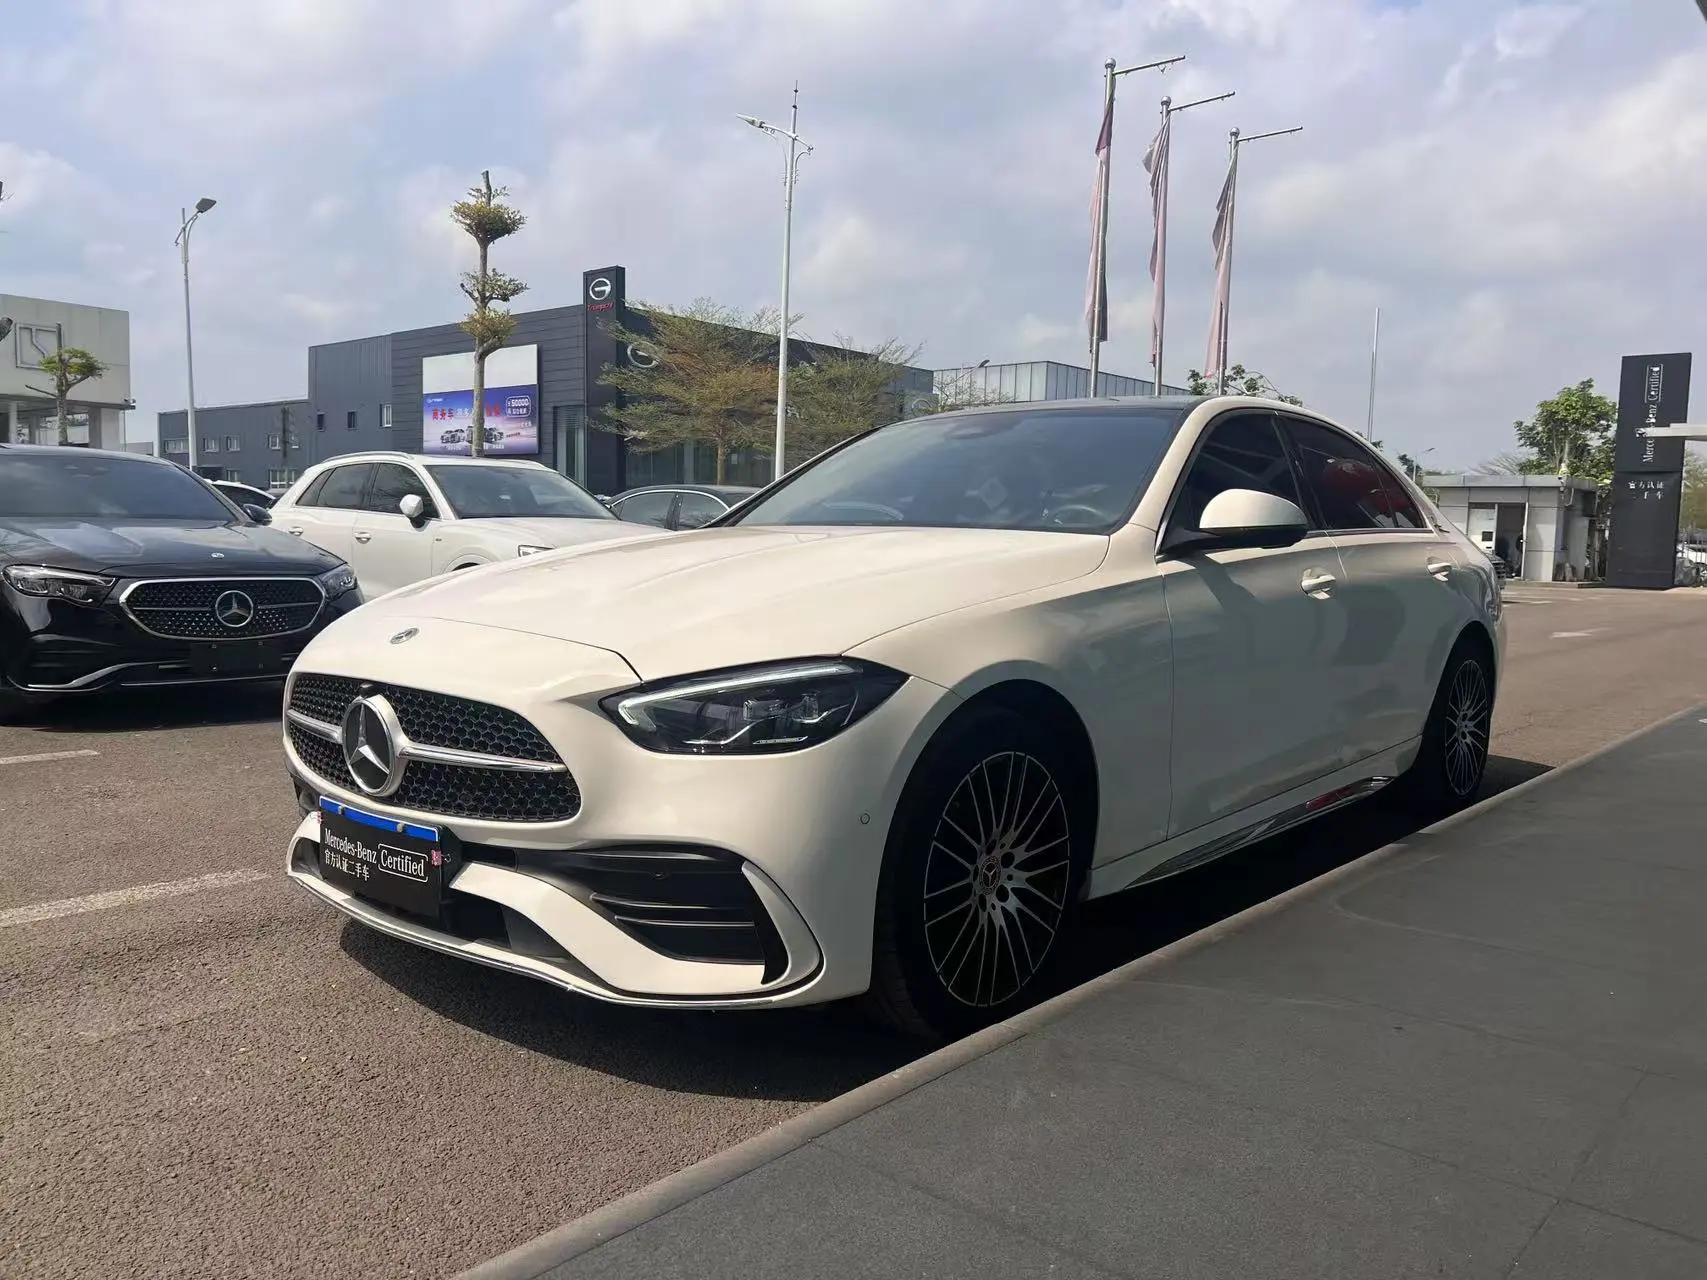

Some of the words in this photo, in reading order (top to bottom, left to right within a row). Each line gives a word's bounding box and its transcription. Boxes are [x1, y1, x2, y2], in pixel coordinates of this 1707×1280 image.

[1642, 404, 1658, 463] Merce-Benz
[324, 828, 377, 864] Mercedes-Benz
[380, 849, 425, 877] Certified
[324, 849, 370, 881] 官方认证二手车
